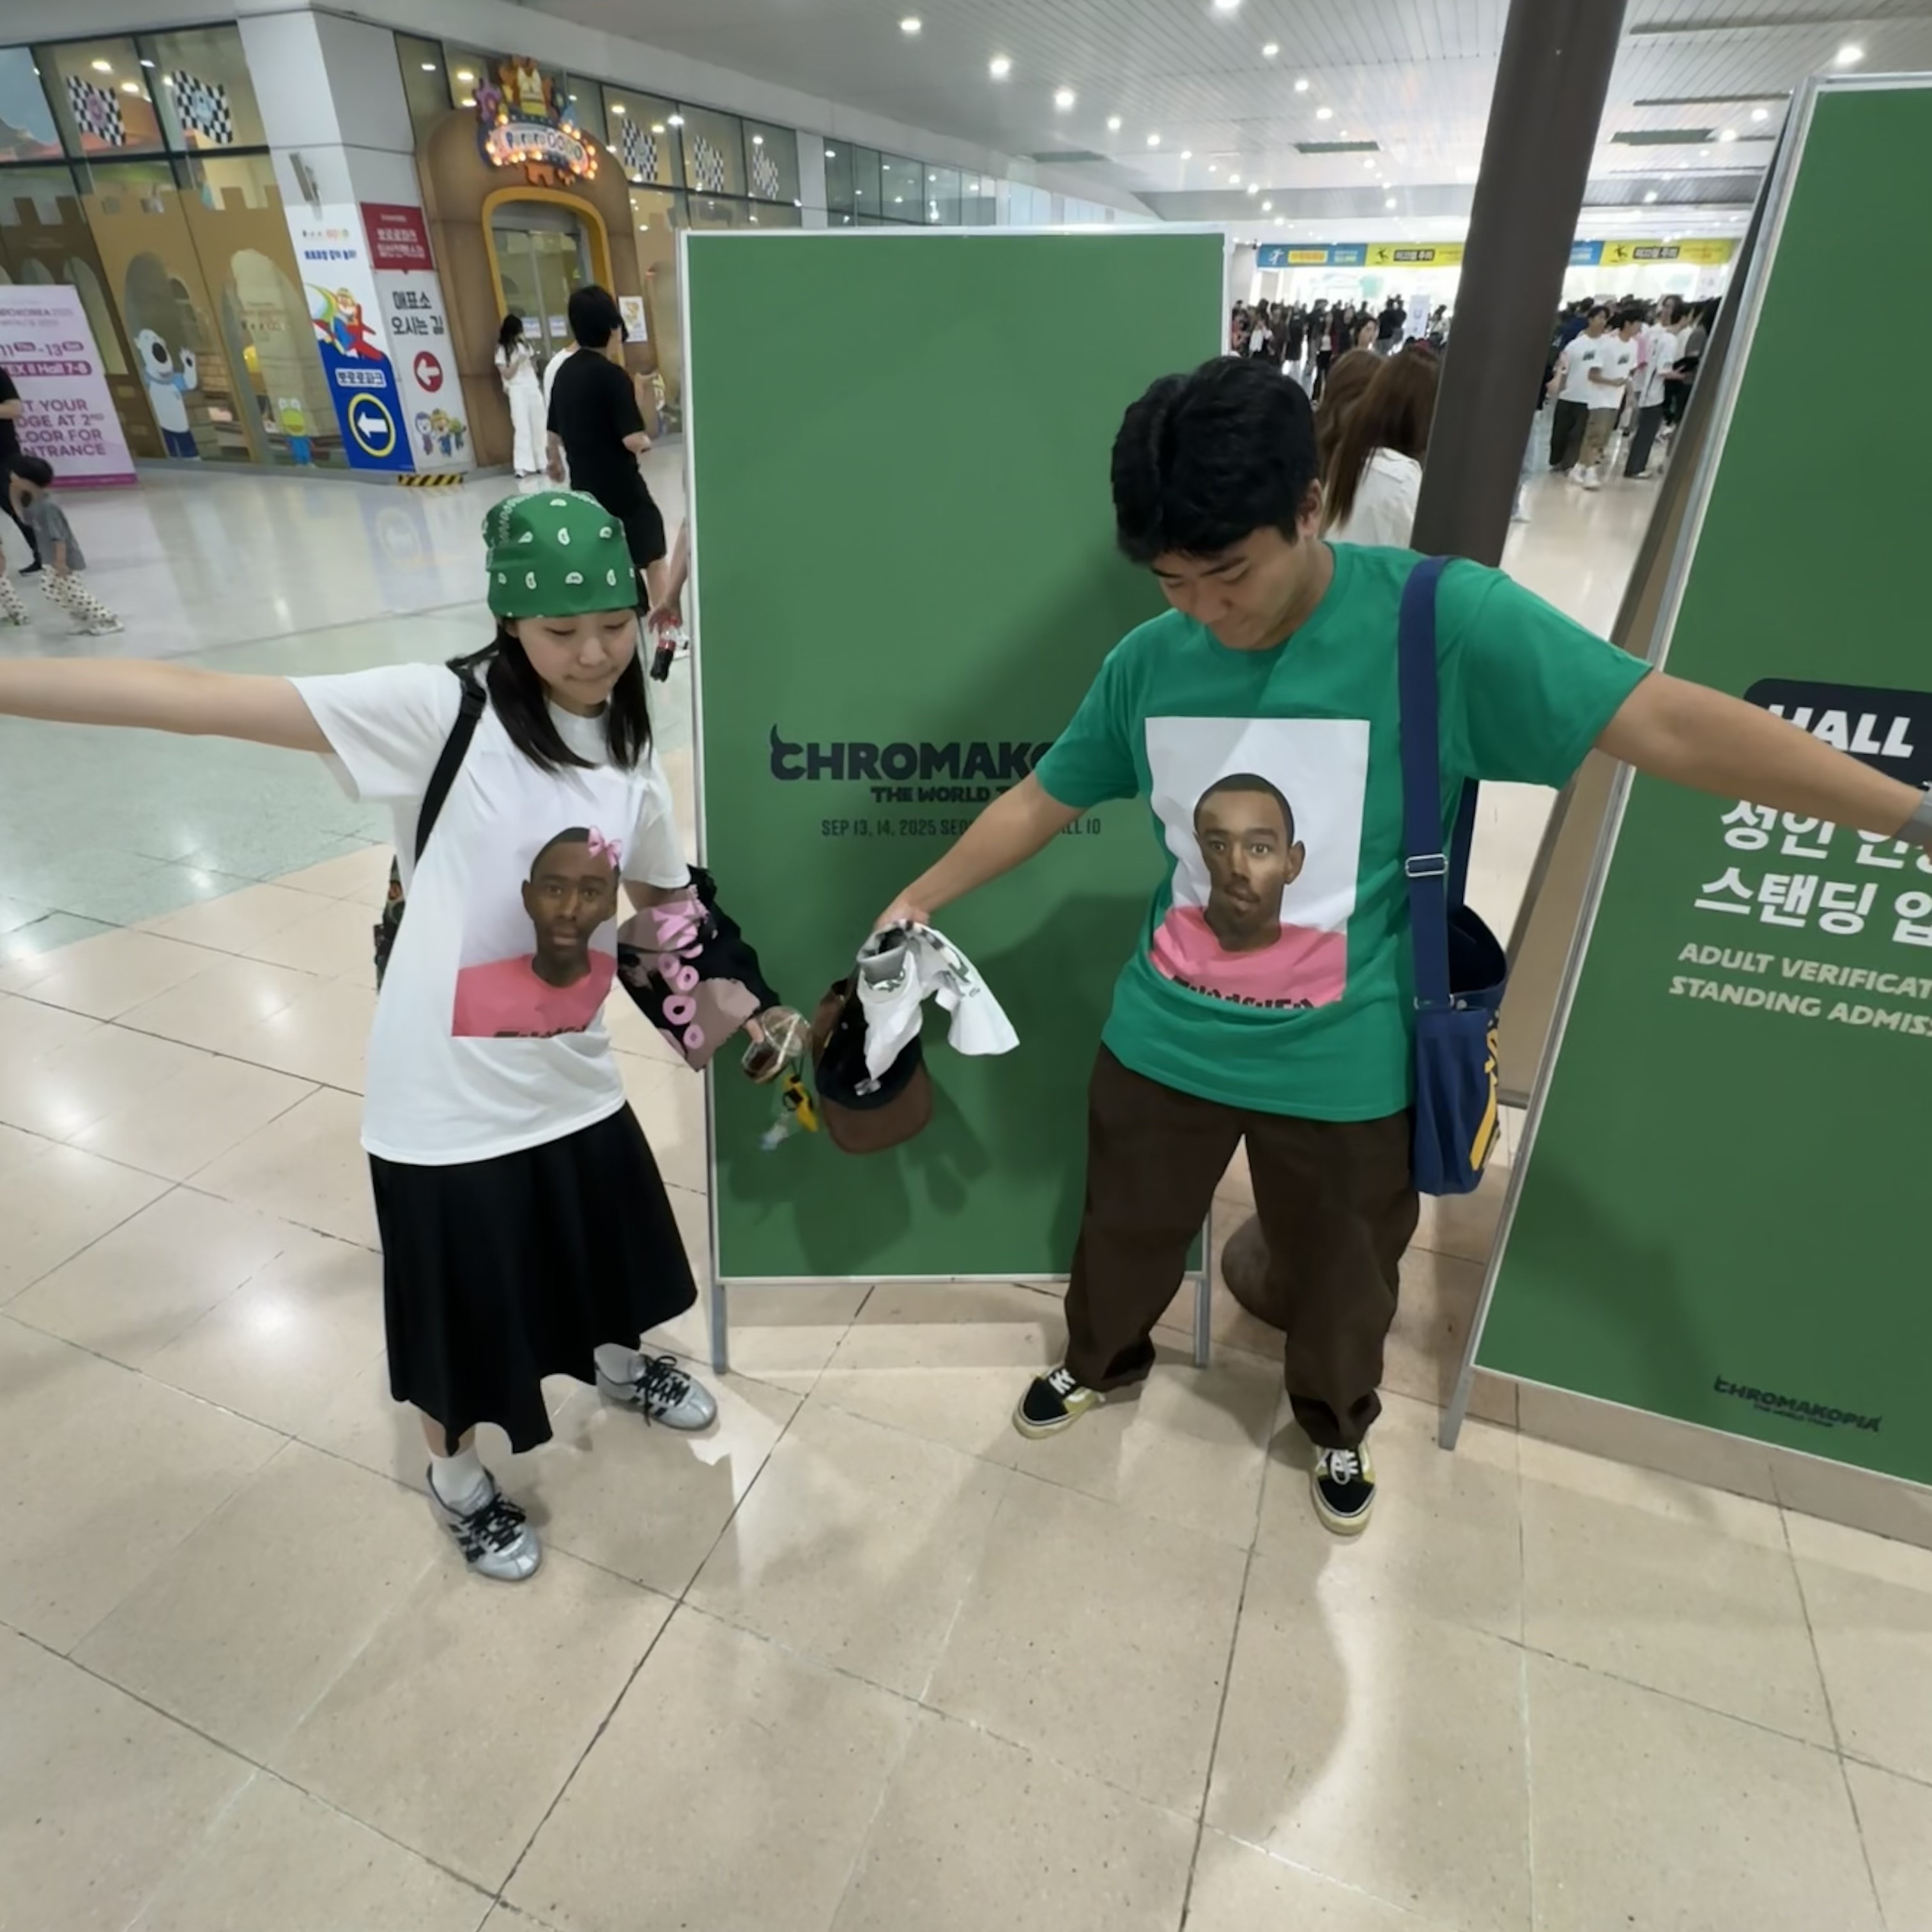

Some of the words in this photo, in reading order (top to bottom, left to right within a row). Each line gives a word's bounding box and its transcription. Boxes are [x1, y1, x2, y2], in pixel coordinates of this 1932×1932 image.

[393, 291, 432, 309] 매표소
[392, 316, 429, 335] 오시는
[430, 316, 444, 335] 길
[40, 399, 88, 411] YOUR
[17, 415, 52, 428] DGE
[57, 415, 75, 426] AT
[17, 430, 63, 443] LOOR
[68, 429, 103, 441] FOR
[23, 443, 106, 457] NTRANCE
[871, 786, 913, 803] THE
[917, 786, 990, 803] WORLD
[822, 820, 849, 836] SEP
[899, 820, 937, 836] 2025
[940, 819, 973, 835] SEO
[1694, 866, 1878, 935] 스탠딩
[1678, 942, 1775, 974] ADULT
[1669, 976, 1821, 1017] STANDING
[1713, 1375, 1882, 1432] CHROMAKOPIA
